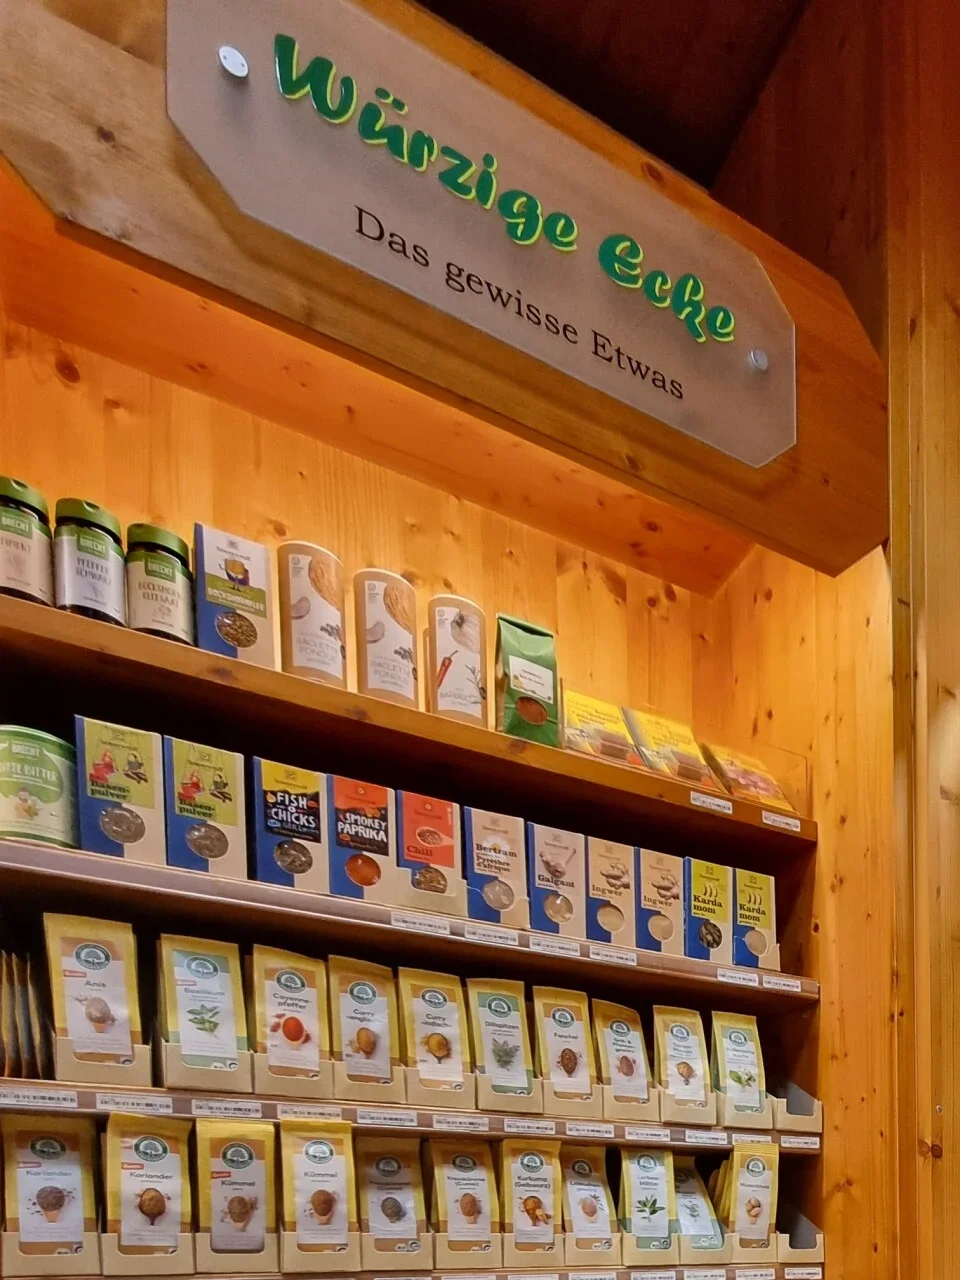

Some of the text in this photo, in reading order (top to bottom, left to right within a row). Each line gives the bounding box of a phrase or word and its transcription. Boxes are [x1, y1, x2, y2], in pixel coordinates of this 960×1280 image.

[274, 32, 736, 344] Würzige Ecke
[354, 205, 686, 401] Das gewisse Etwas
[276, 792, 308, 810] FISH
[271, 808, 317, 829] CHICKS
[345, 812, 388, 831] SMOKEY
[337, 821, 388, 843] PAPRIKA
[475, 843, 518, 858] Bertram
[537, 873, 575, 889] Galgant
[591, 884, 623, 897] Ingwer
[643, 894, 673, 908] Ingwer
[693, 893, 723, 909] Karda
[693, 903, 716, 915] mom
[739, 903, 766, 917] Karda
[739, 911, 760, 923] mom
[85, 979, 107, 989] Anis
[353, 1008, 375, 1019] Curry
[425, 1013, 446, 1023] Curry
[26, 1169, 72, 1177] Koriander
[129, 1171, 174, 1181] Koriander
